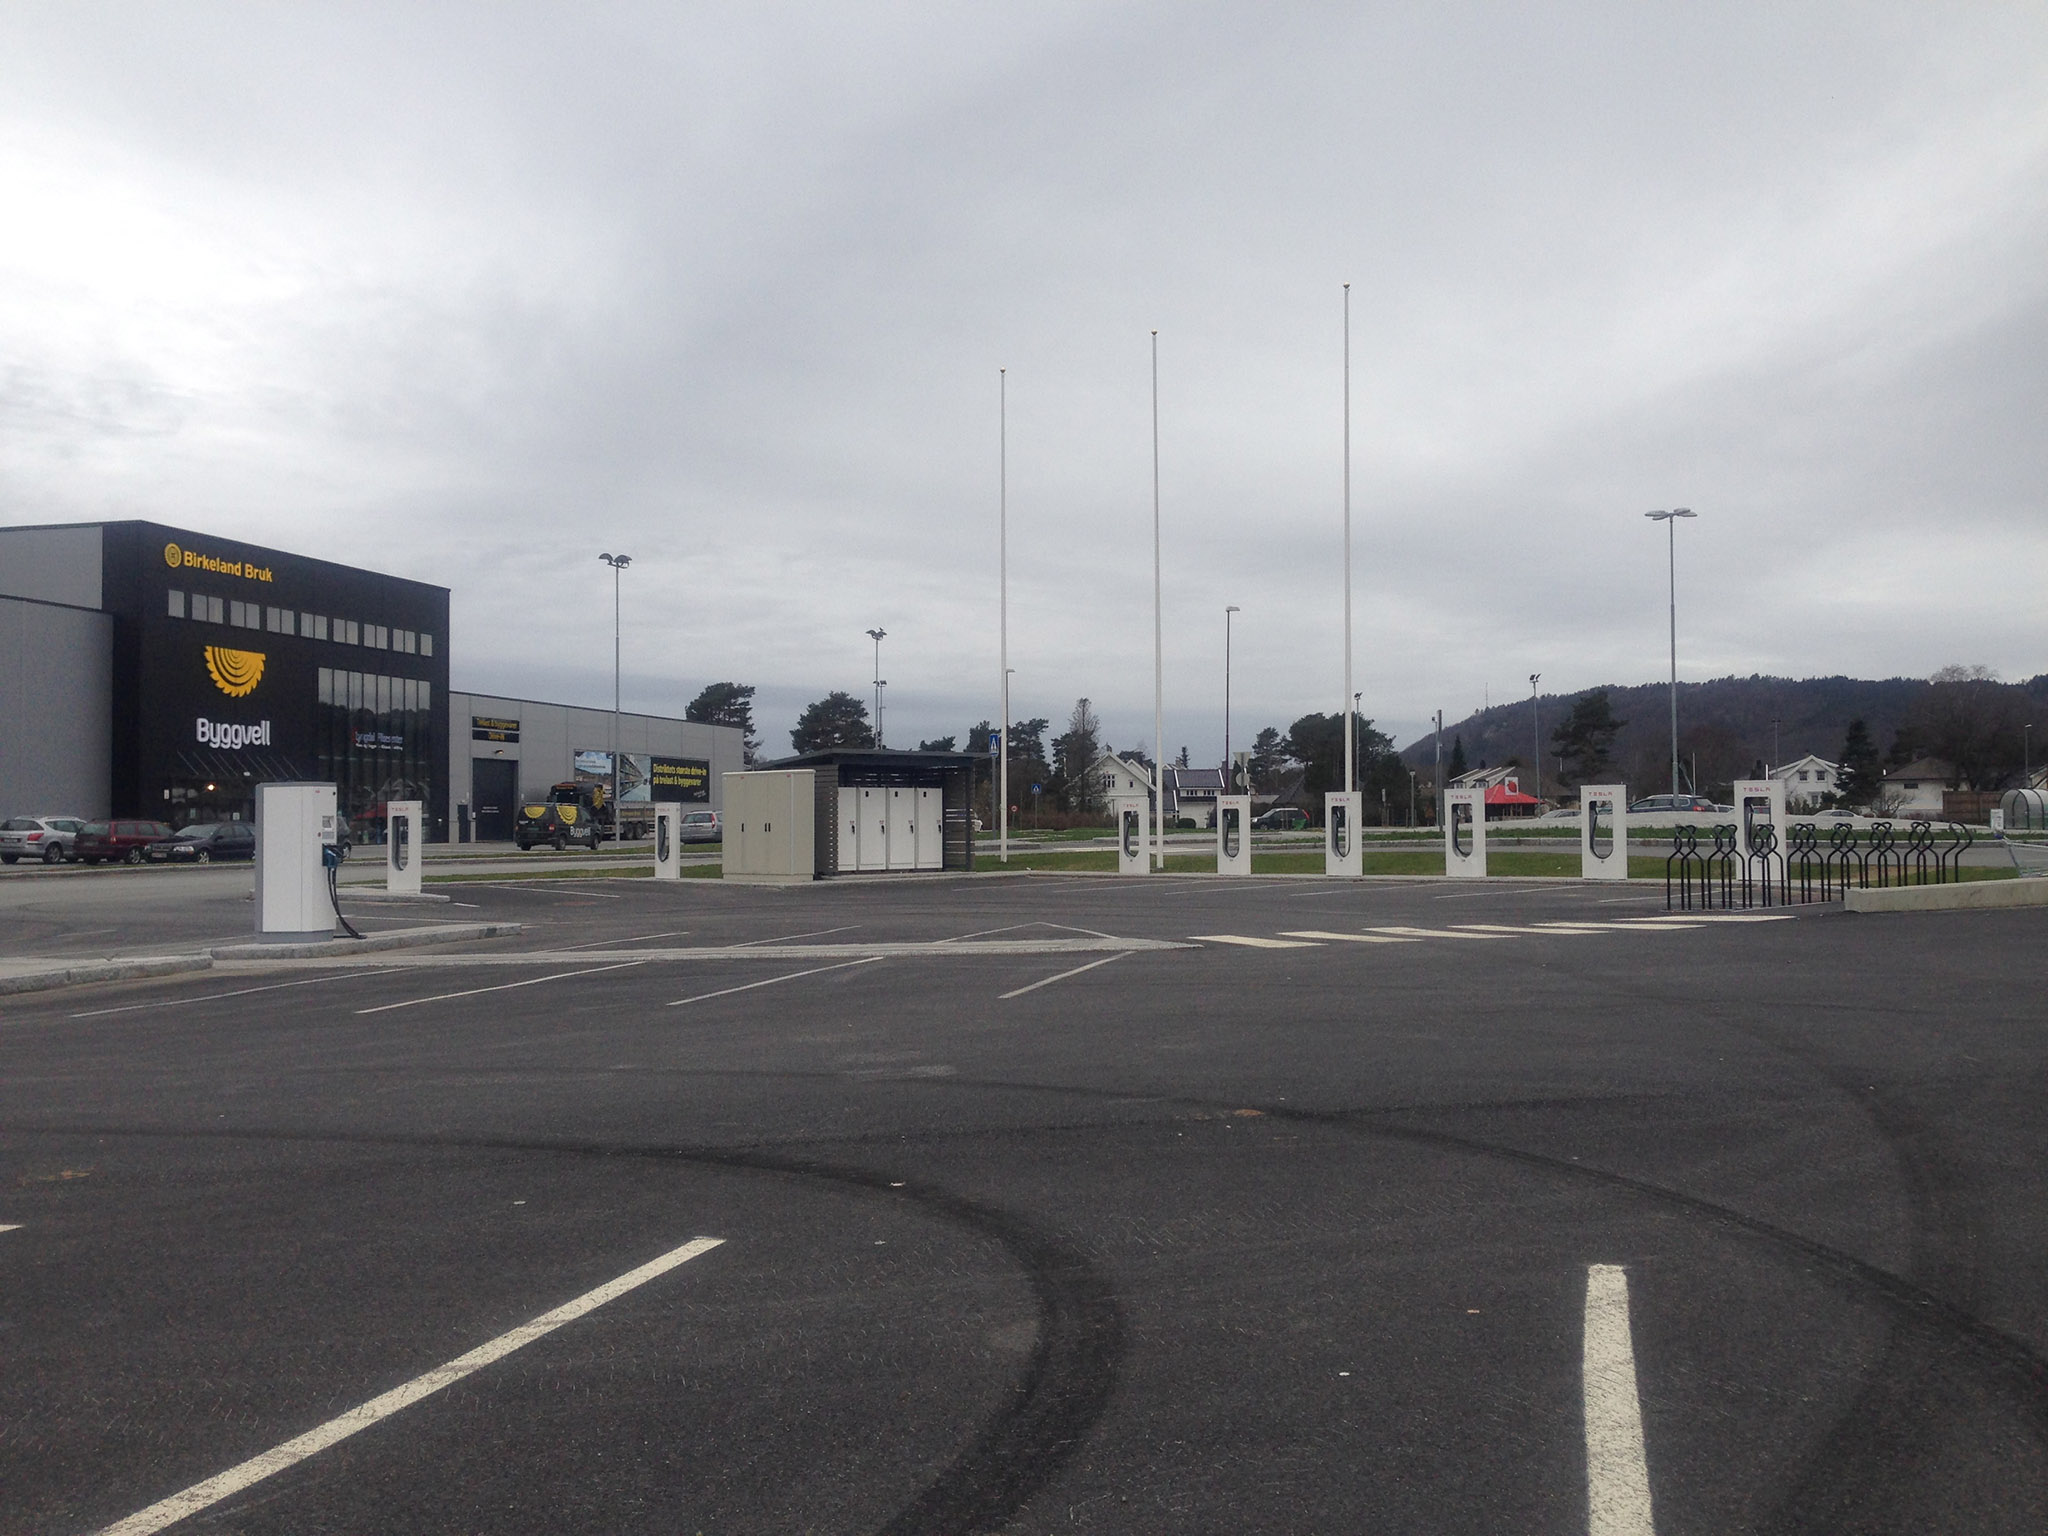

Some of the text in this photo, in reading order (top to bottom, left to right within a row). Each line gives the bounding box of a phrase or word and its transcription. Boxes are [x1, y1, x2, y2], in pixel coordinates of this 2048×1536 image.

[184, 551, 272, 582] Birkeland Bruk
[196, 717, 271, 750] Byggvell
